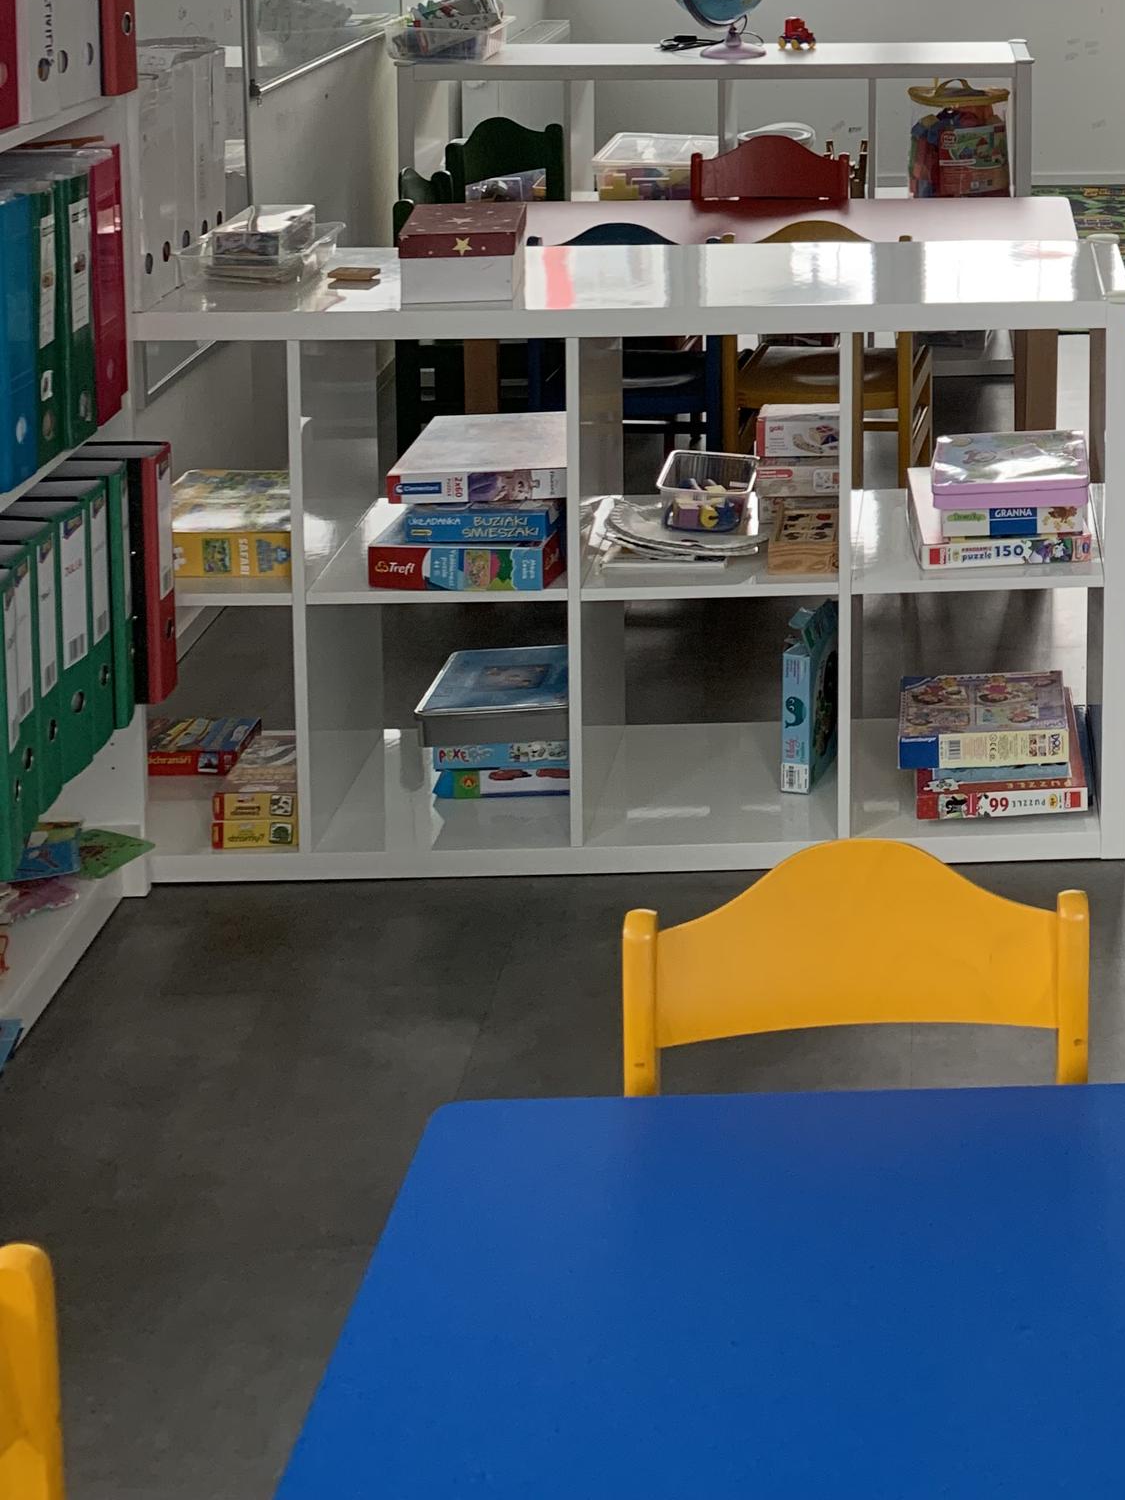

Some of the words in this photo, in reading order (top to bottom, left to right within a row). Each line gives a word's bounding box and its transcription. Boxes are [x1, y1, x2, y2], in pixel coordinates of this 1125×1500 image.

[455, 476, 464, 498] 2x60
[995, 508, 1033, 518] GRANNA
[473, 516, 528, 526] BUZIAKI
[239, 538, 250, 575] SAFARI
[962, 552, 992, 562] puzzle
[995, 545, 1024, 557] 150
[388, 561, 415, 574] Trefl
[989, 797, 1009, 813] 66
[1012, 799, 1046, 809] PUZZLE
